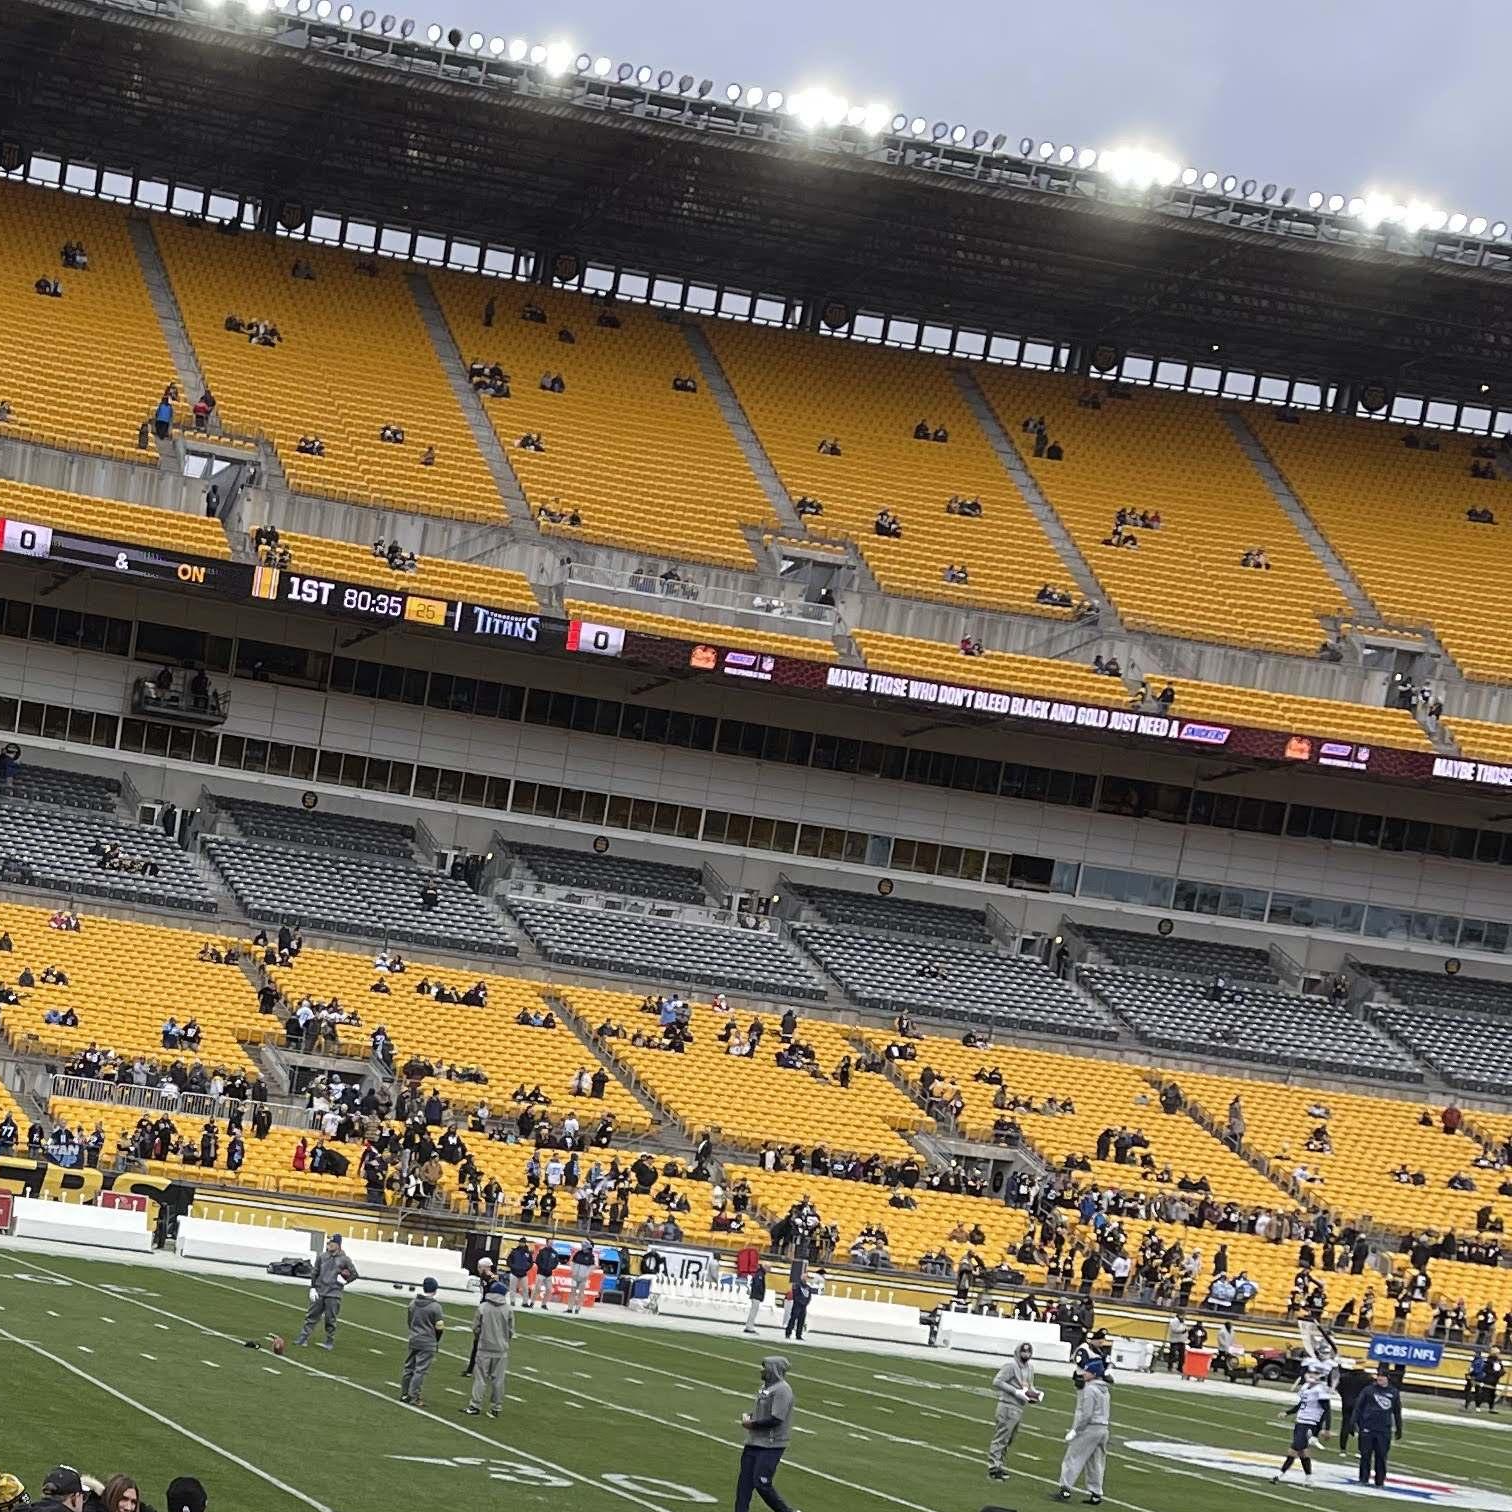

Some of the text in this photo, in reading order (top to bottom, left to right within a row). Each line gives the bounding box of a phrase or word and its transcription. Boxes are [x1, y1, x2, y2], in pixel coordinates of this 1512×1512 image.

[20, 529, 36, 550] 0
[177, 563, 206, 583] ON
[288, 576, 335, 606] 1ST
[343, 588, 403, 617] 80:35
[416, 602, 436, 620] 25
[473, 606, 610, 650] TITANS 0
[826, 667, 870, 691] MAYBE
[869, 674, 908, 697] THOSE
[908, 680, 938, 702] WHO
[938, 685, 976, 708] DON'T
[974, 691, 1010, 714] BLEED
[1009, 697, 1050, 720] BLACK
[1049, 702, 1076, 723] AND
[1076, 706, 1109, 728] GOLD
[1108, 710, 1138, 732] JUST
[1138, 715, 1169, 737] NEED
[1168, 720, 1180, 738] A
[1476, 763, 1512, 786] THOS
[1383, 1345, 1436, 1361] CBS NFL
